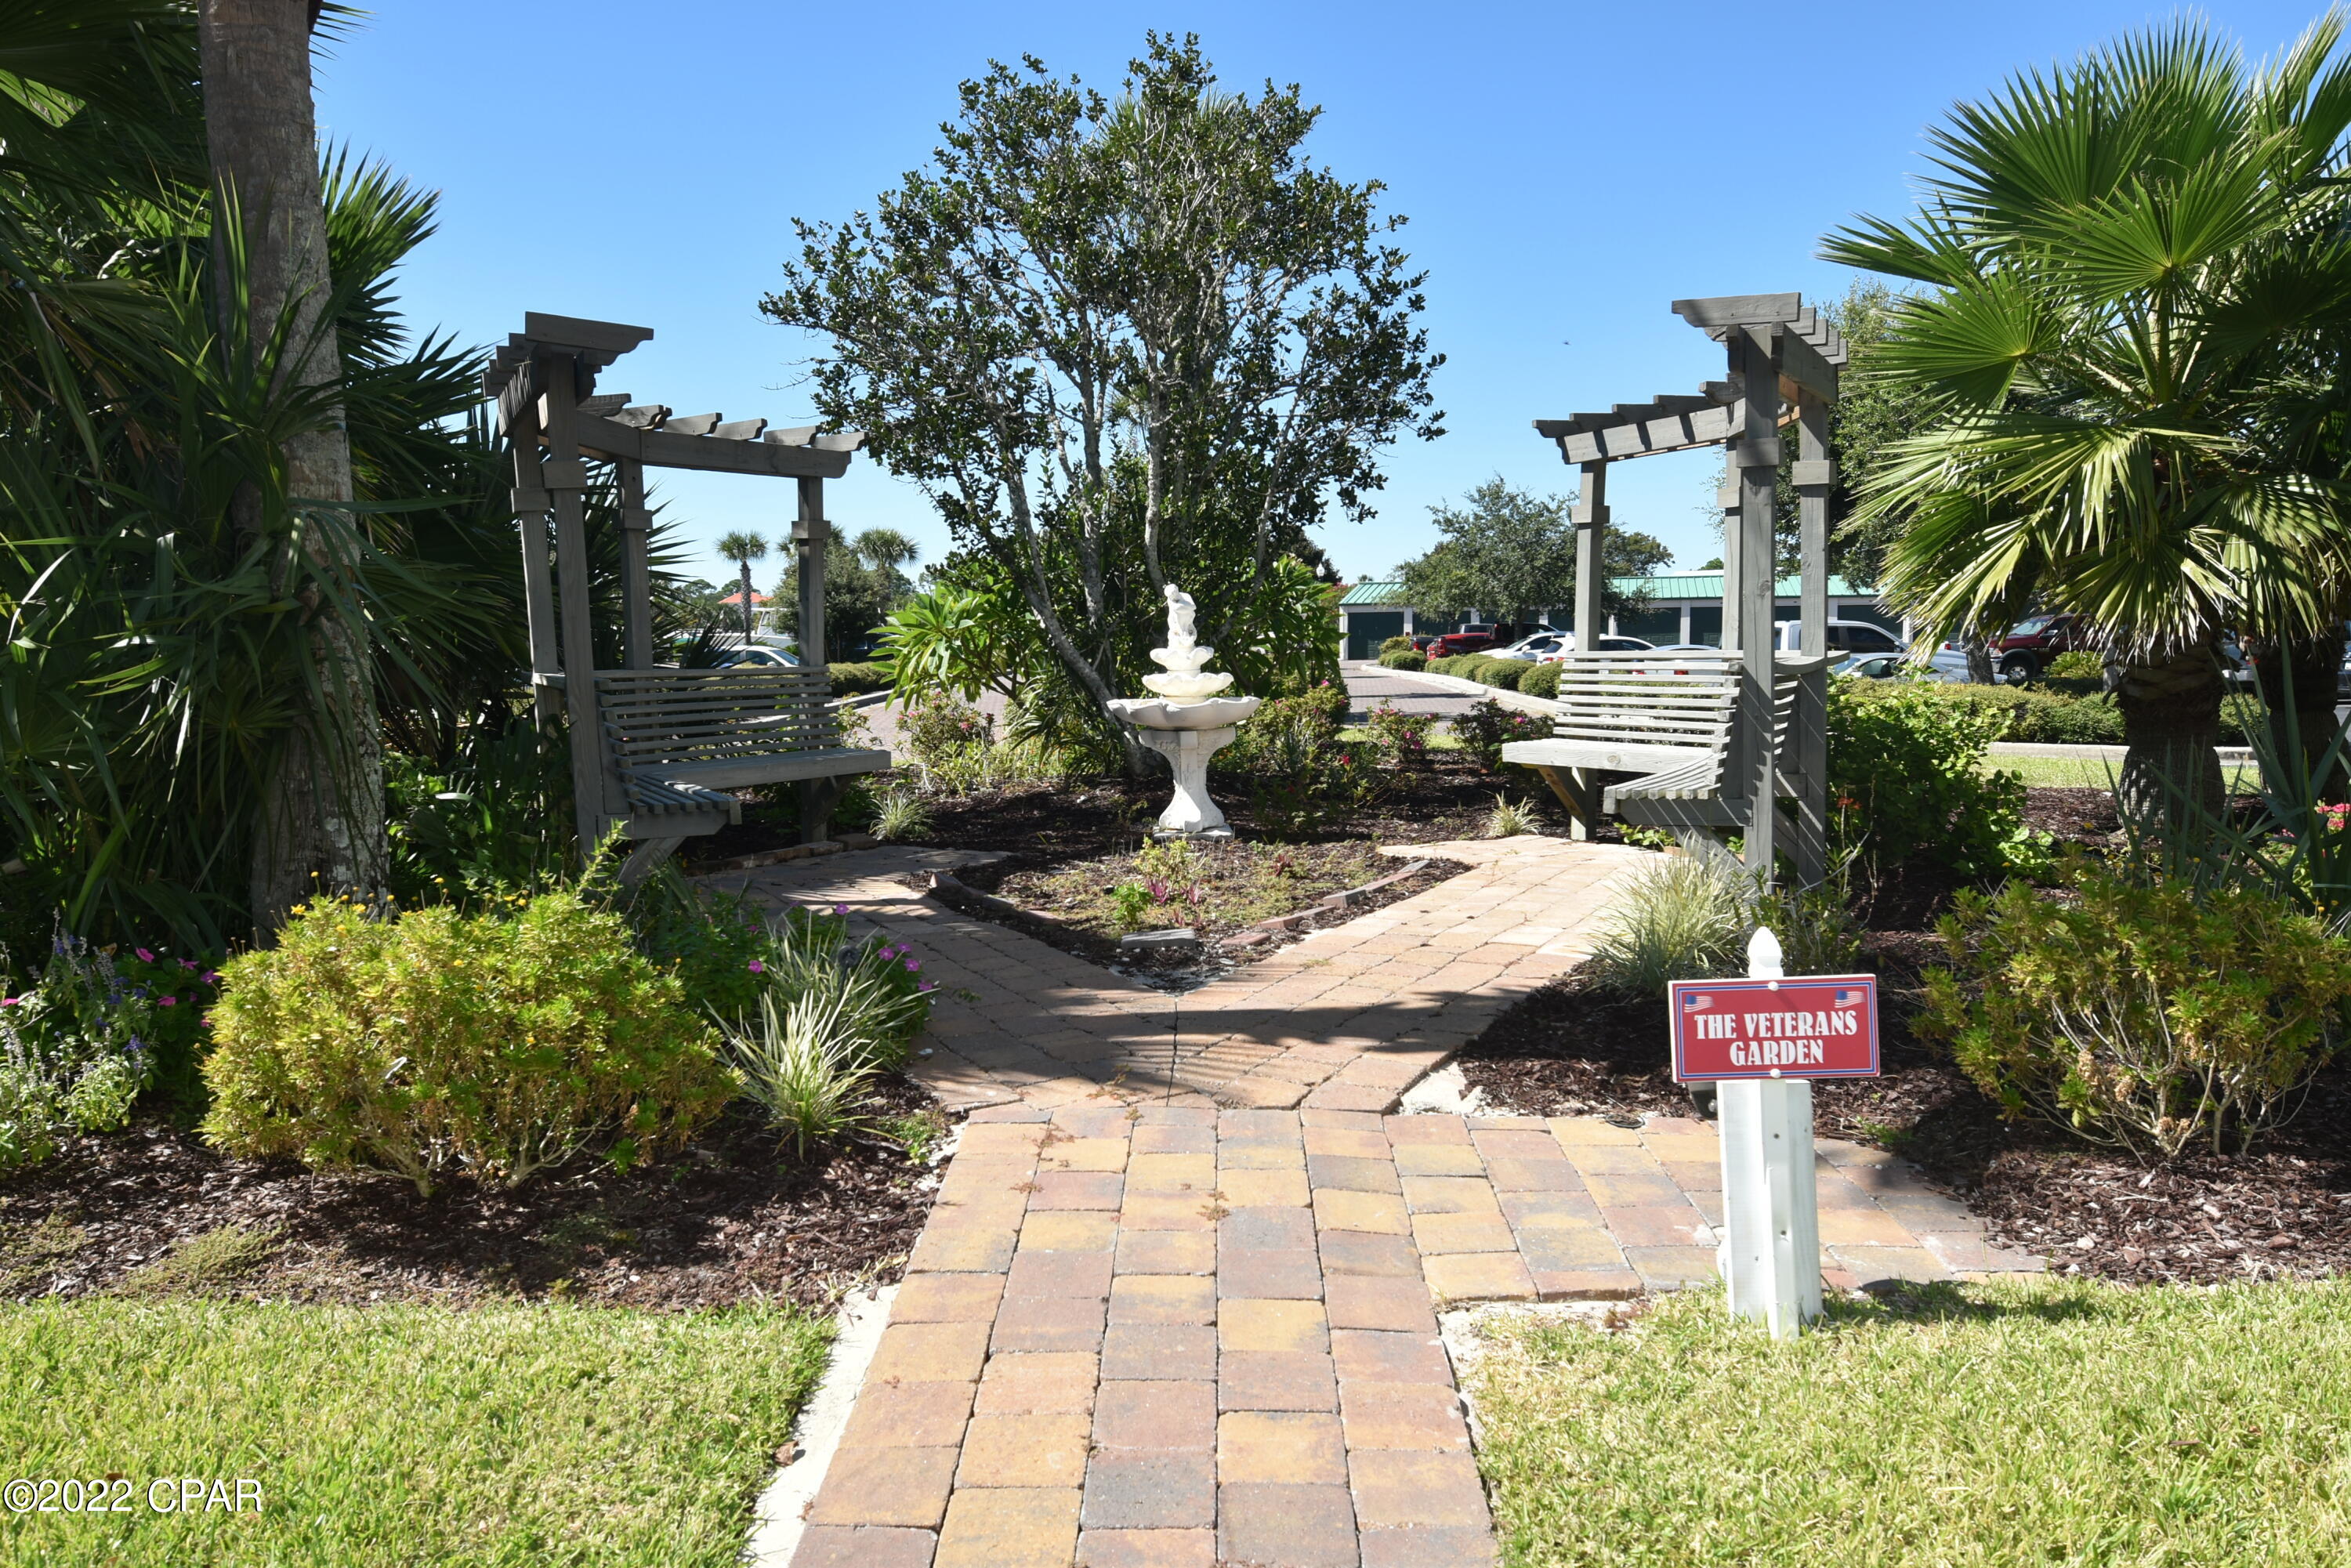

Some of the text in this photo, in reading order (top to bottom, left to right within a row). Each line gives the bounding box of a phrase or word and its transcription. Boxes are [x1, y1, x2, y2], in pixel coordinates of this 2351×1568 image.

[1694, 1009, 1858, 1040] THE VETERANS
[1729, 1038, 1824, 1066] GARDEN
